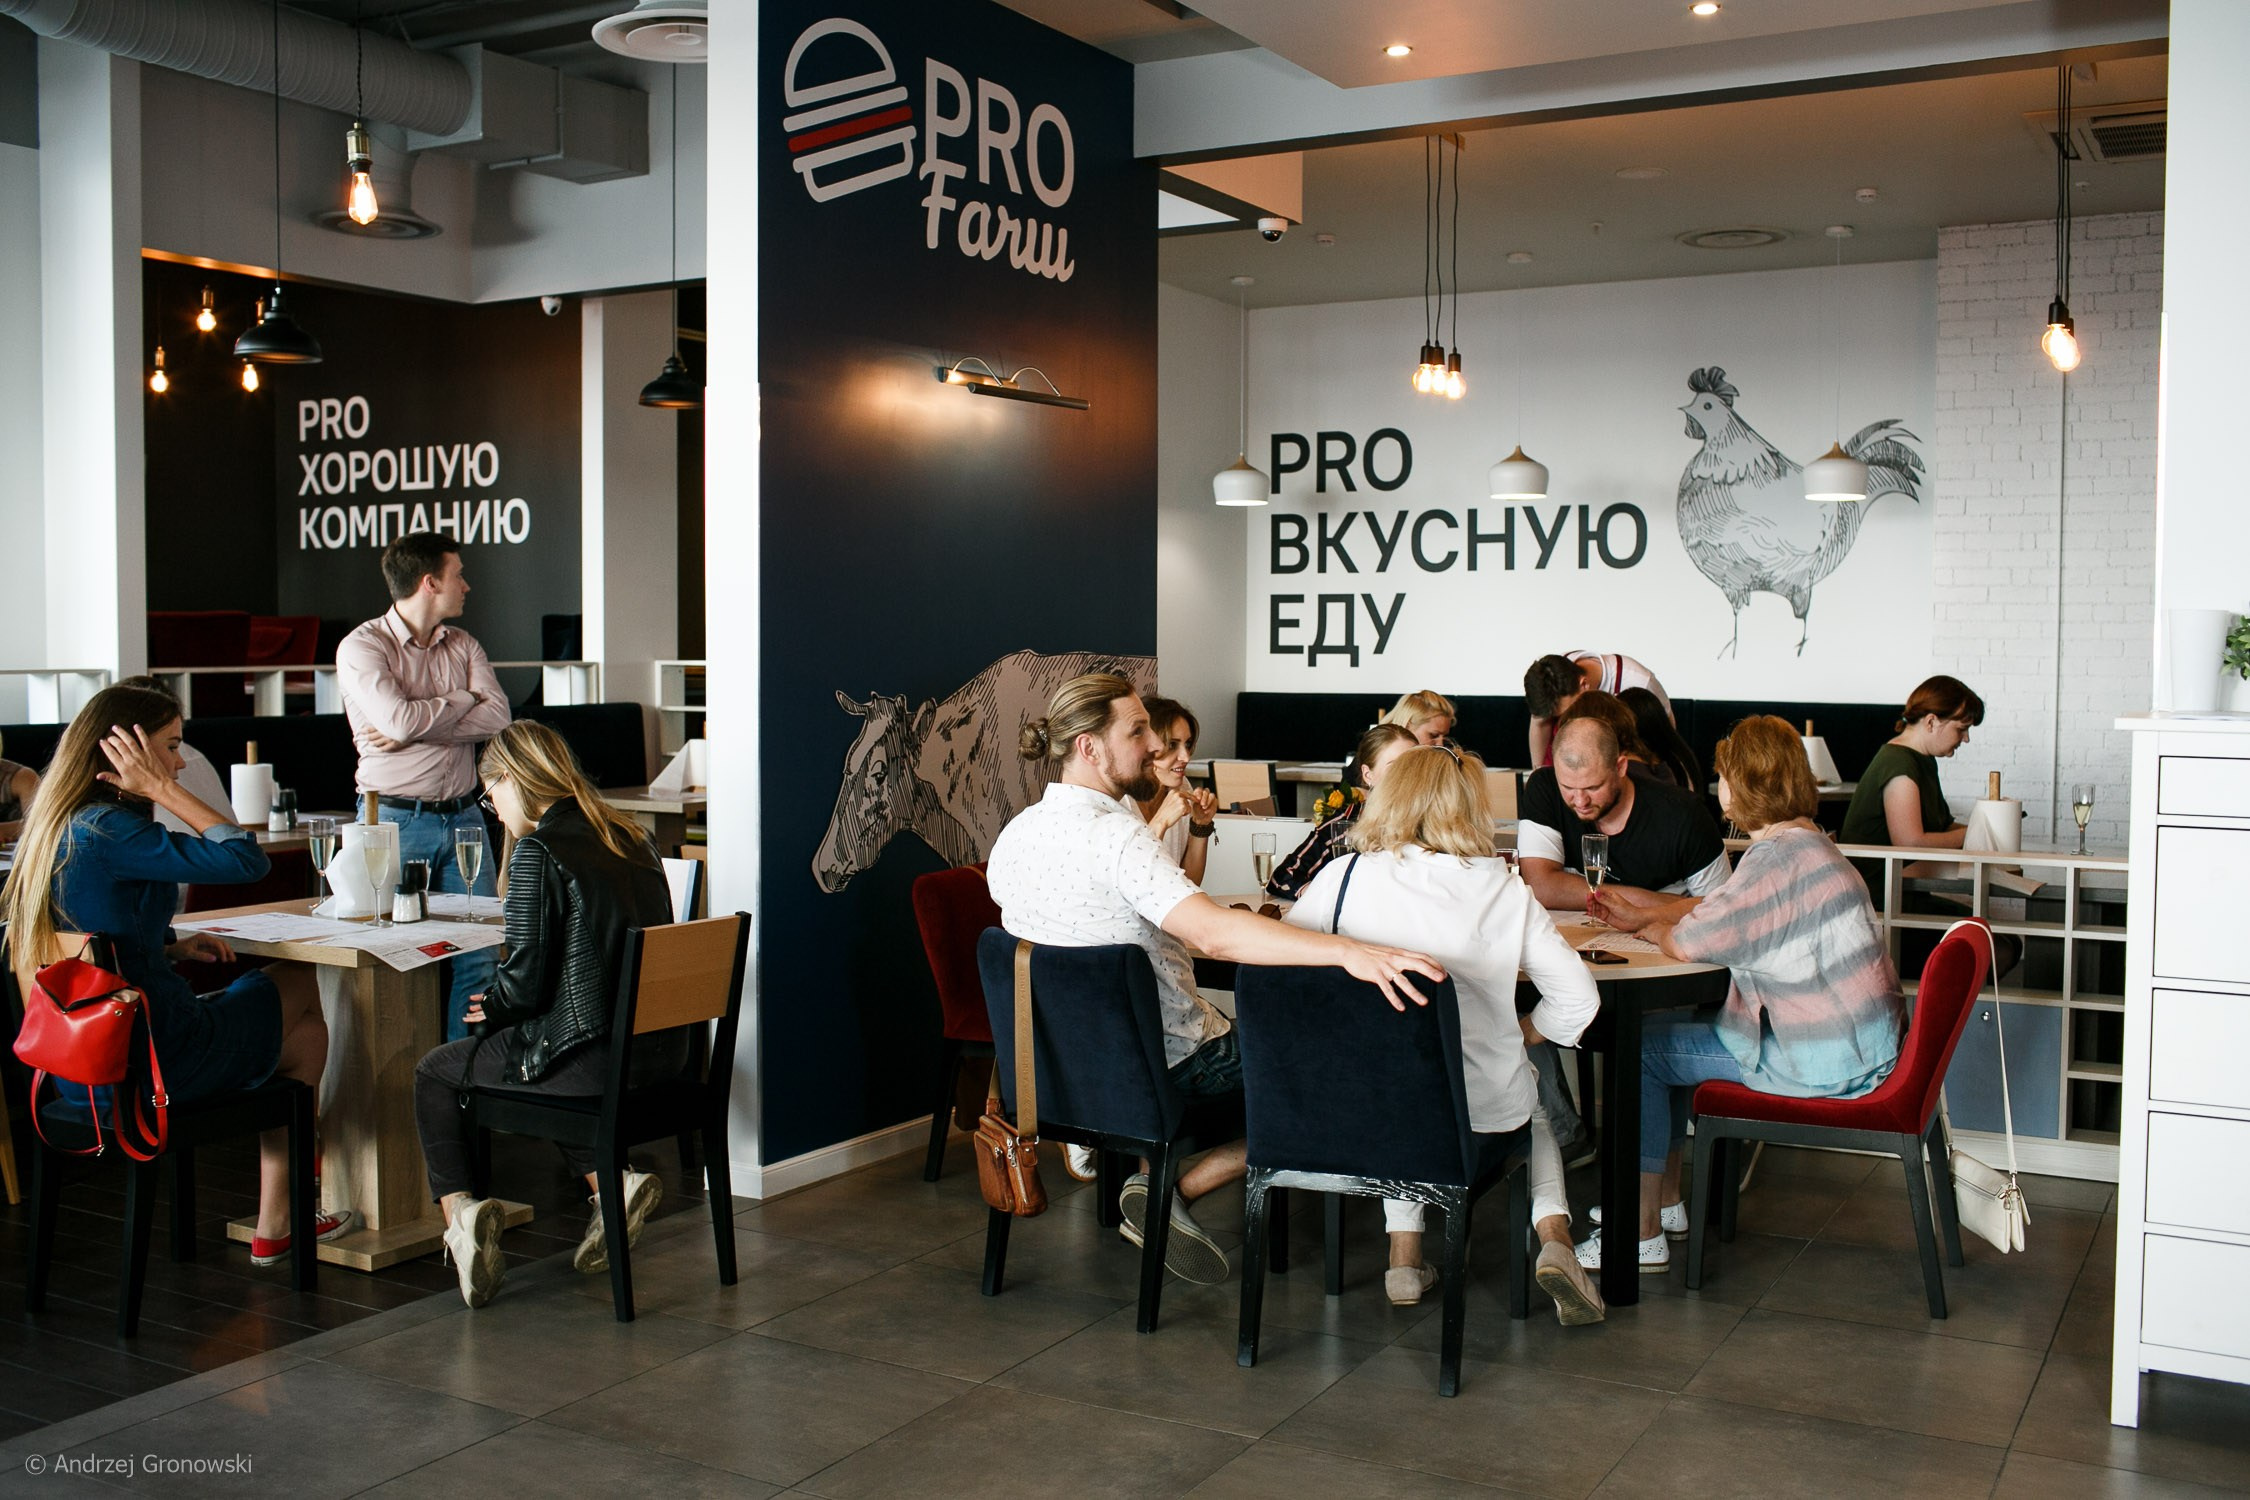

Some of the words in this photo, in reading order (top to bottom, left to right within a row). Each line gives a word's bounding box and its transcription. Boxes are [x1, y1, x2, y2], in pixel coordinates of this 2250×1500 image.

[925, 57, 1076, 208] PRO
[299, 395, 371, 443] PRO
[297, 441, 500, 497] ХОРОШУЮ
[1270, 427, 1414, 495] PRO
[299, 497, 531, 551] КОМПАНИЮ
[1270, 502, 1649, 575] ВКУСНУЮ
[1269, 592, 1407, 669] ЕДУ
